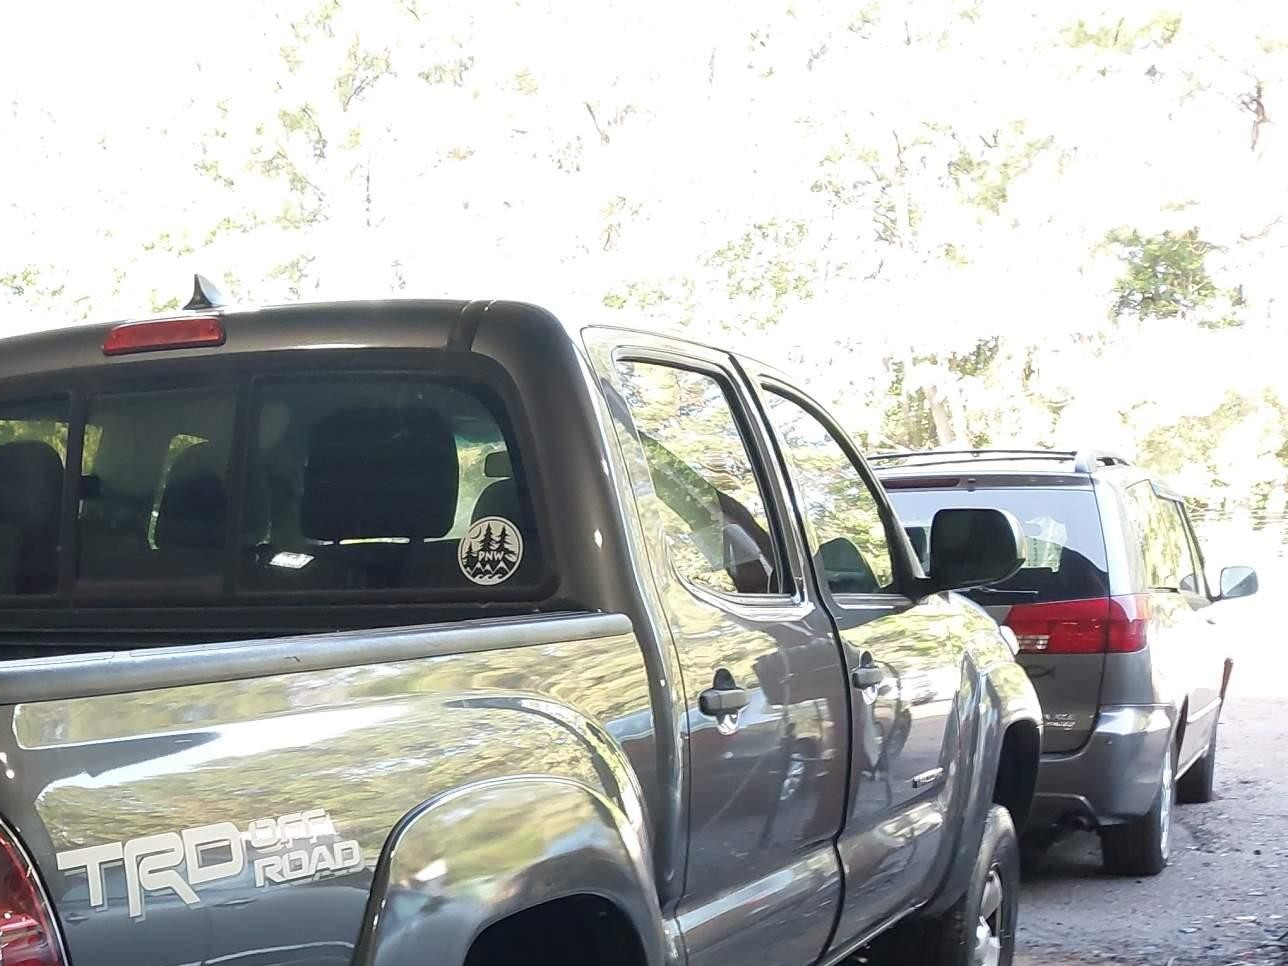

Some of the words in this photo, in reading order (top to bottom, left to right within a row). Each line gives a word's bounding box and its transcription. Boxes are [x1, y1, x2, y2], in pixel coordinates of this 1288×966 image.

[478, 550, 505, 562] PNW
[248, 808, 338, 853] OFF
[56, 821, 245, 919] TRD
[253, 839, 362, 888] ROAD
